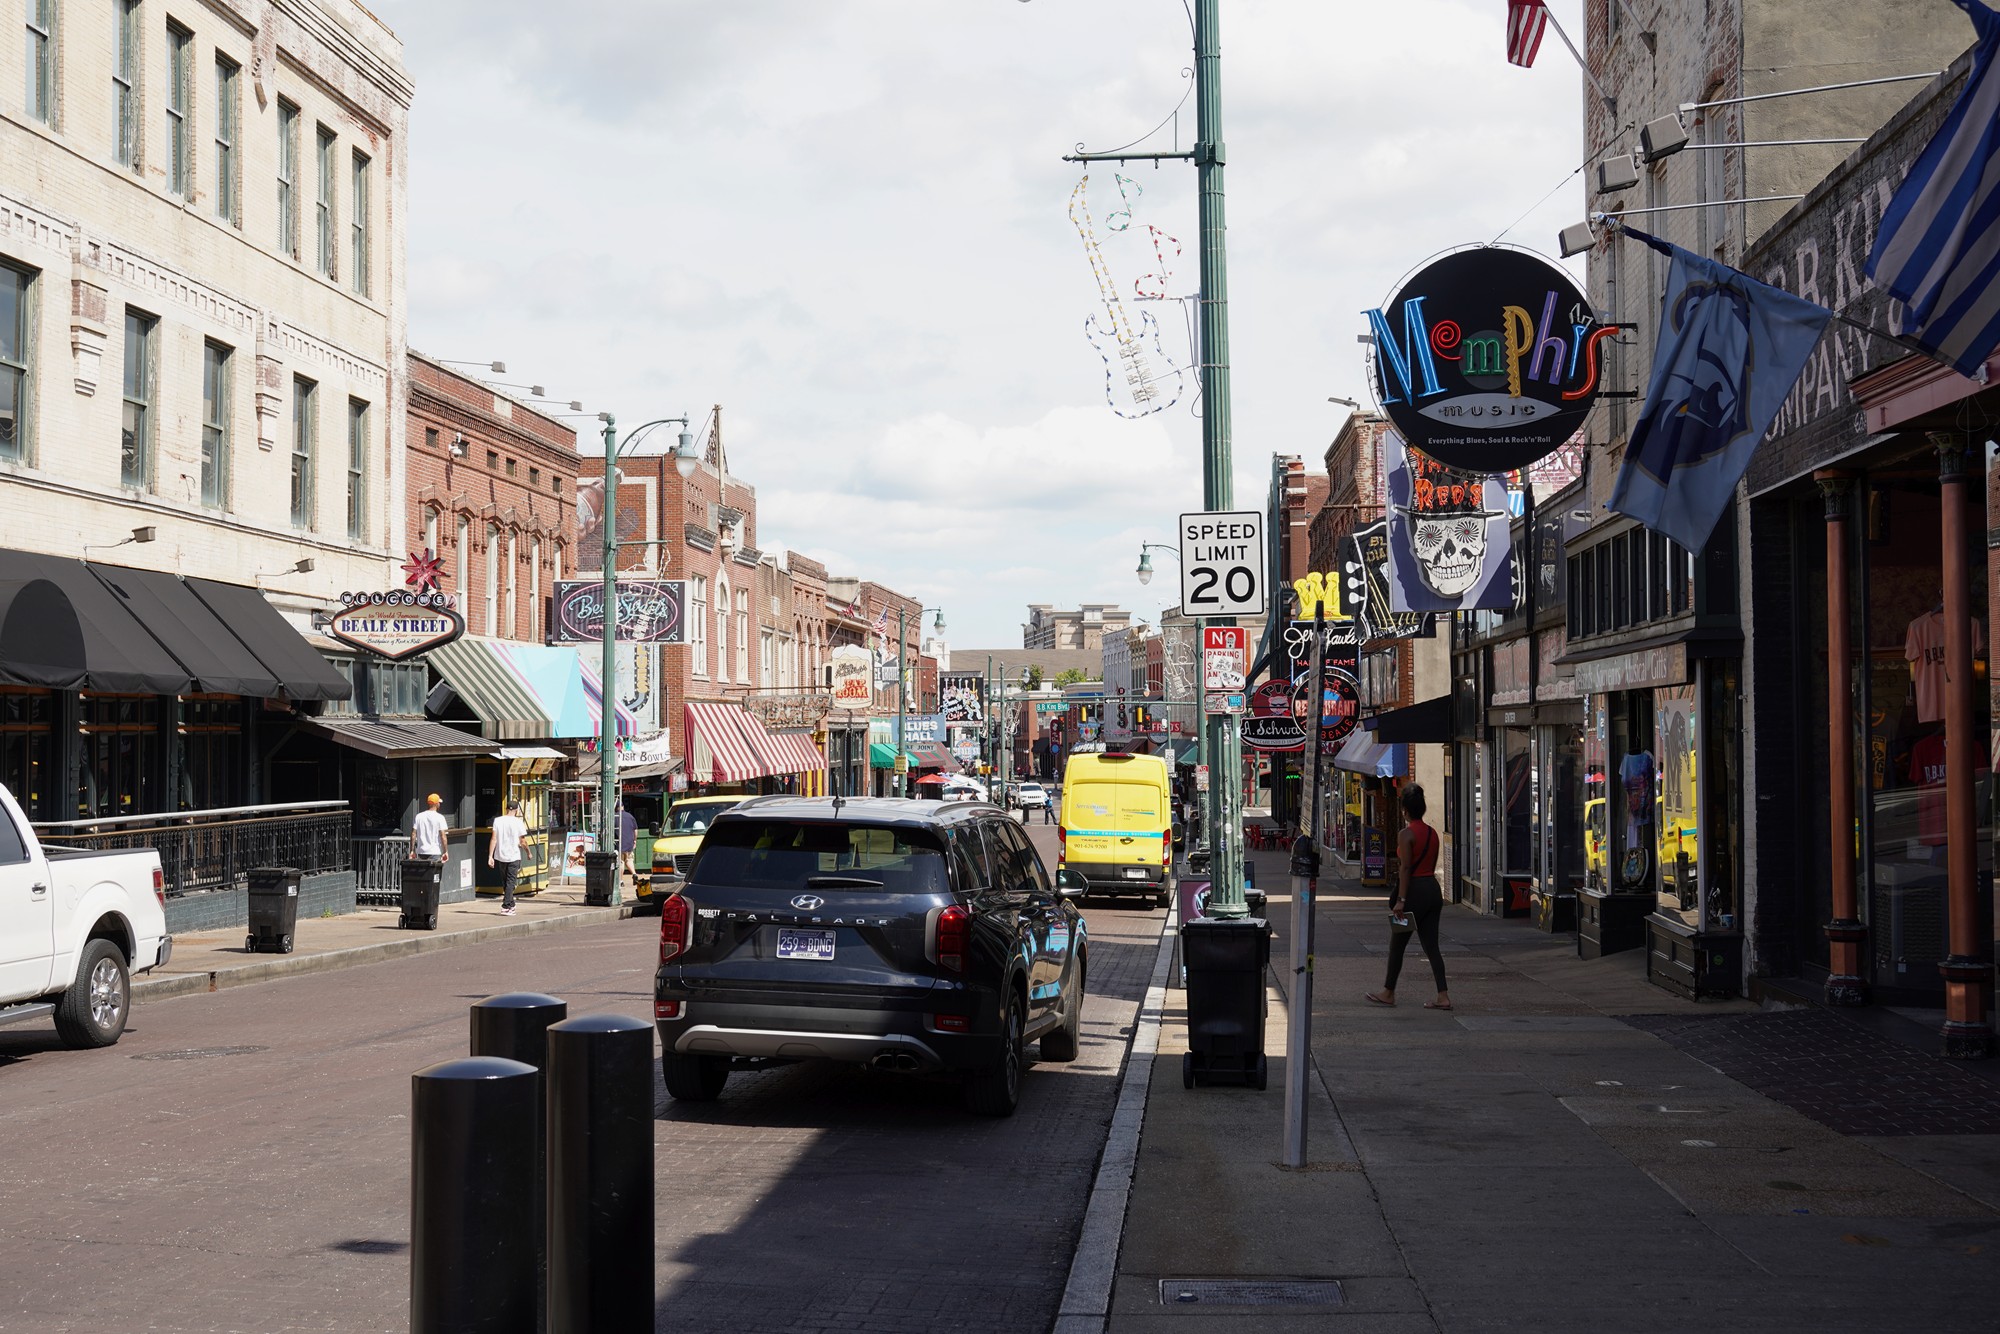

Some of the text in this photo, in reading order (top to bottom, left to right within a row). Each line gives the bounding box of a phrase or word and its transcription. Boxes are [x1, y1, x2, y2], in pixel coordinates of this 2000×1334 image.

[1360, 290, 1620, 407] Memphis
[1428, 437, 1464, 445] Everything
[1466, 436, 1488, 445] Blues,
[1511, 436, 1551, 444] Rock'n'Roll
[1187, 524, 1256, 541] SPEED
[1195, 545, 1248, 561] LIMIT
[1189, 566, 1256, 604] 20
[341, 592, 446, 606] WELCOME
[341, 619, 447, 632] BEALE STREET
[1624, 653, 1648, 685] Musical
[1650, 646, 1668, 680] Gifts
[835, 688, 869, 698] ROOM
[1046, 704, 1056, 712] King
[1056, 703, 1068, 711] Blvd
[727, 912, 889, 926] PALISADE
[780, 936, 831, 953] 259 BDNG
